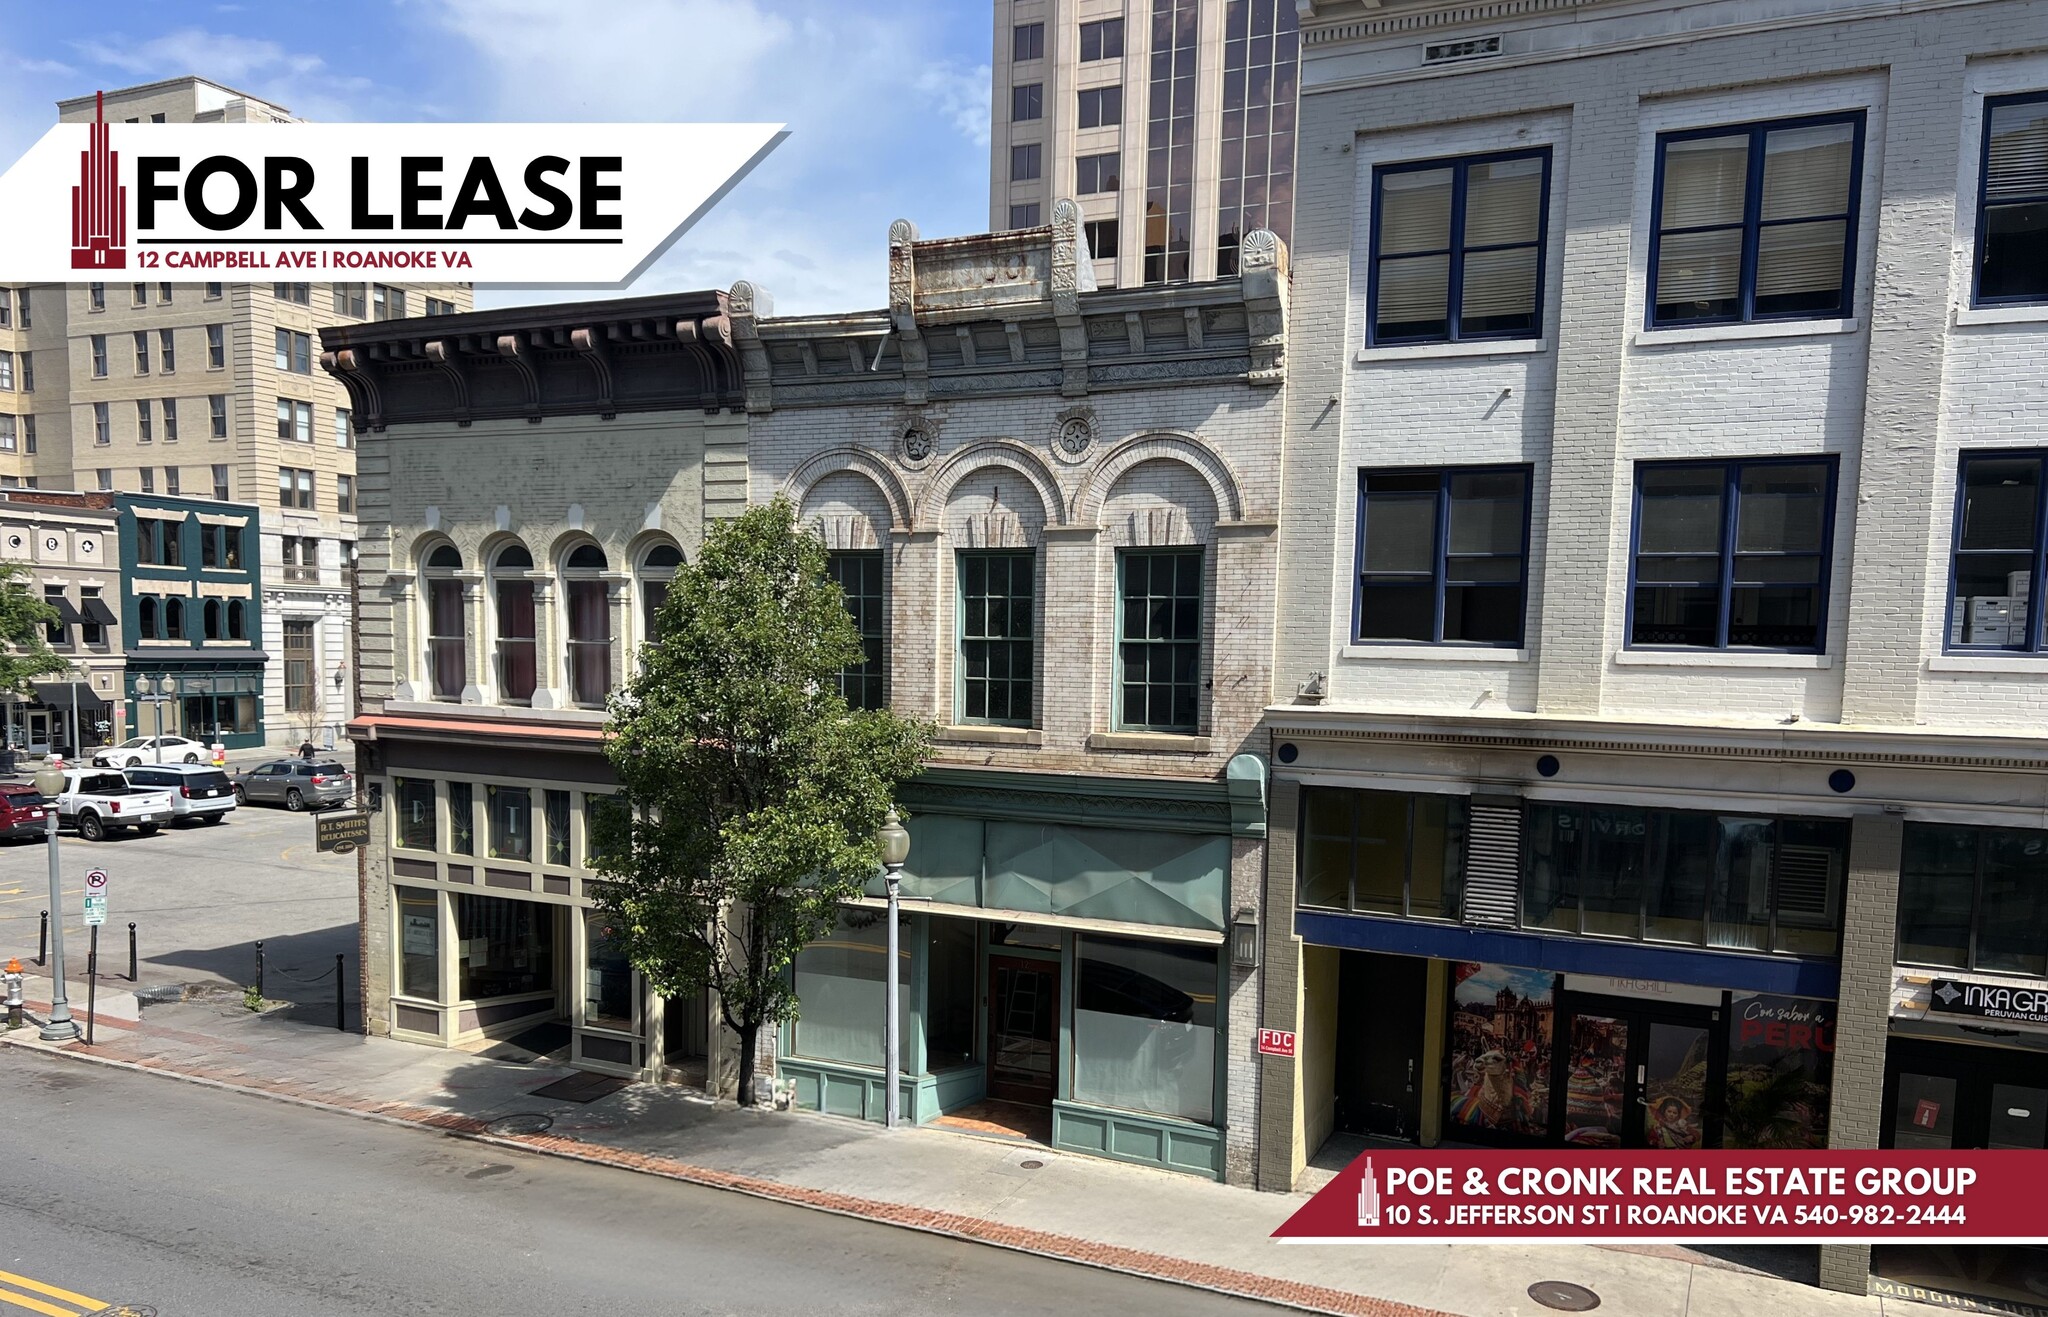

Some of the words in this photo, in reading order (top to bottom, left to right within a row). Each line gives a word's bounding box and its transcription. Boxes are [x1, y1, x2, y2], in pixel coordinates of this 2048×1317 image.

[321, 829, 367, 841] DELICATESSEN
[1964, 985, 2010, 1010] INKA
[1744, 1001, 1774, 1021] Con
[1777, 1005, 1810, 1021] sabor
[1815, 1014, 1825, 1023] a
[1984, 1008, 2028, 1020] PERUVIAN
[1262, 1031, 1292, 1047] FDC
[1741, 1020, 1837, 1052] PERÚ
